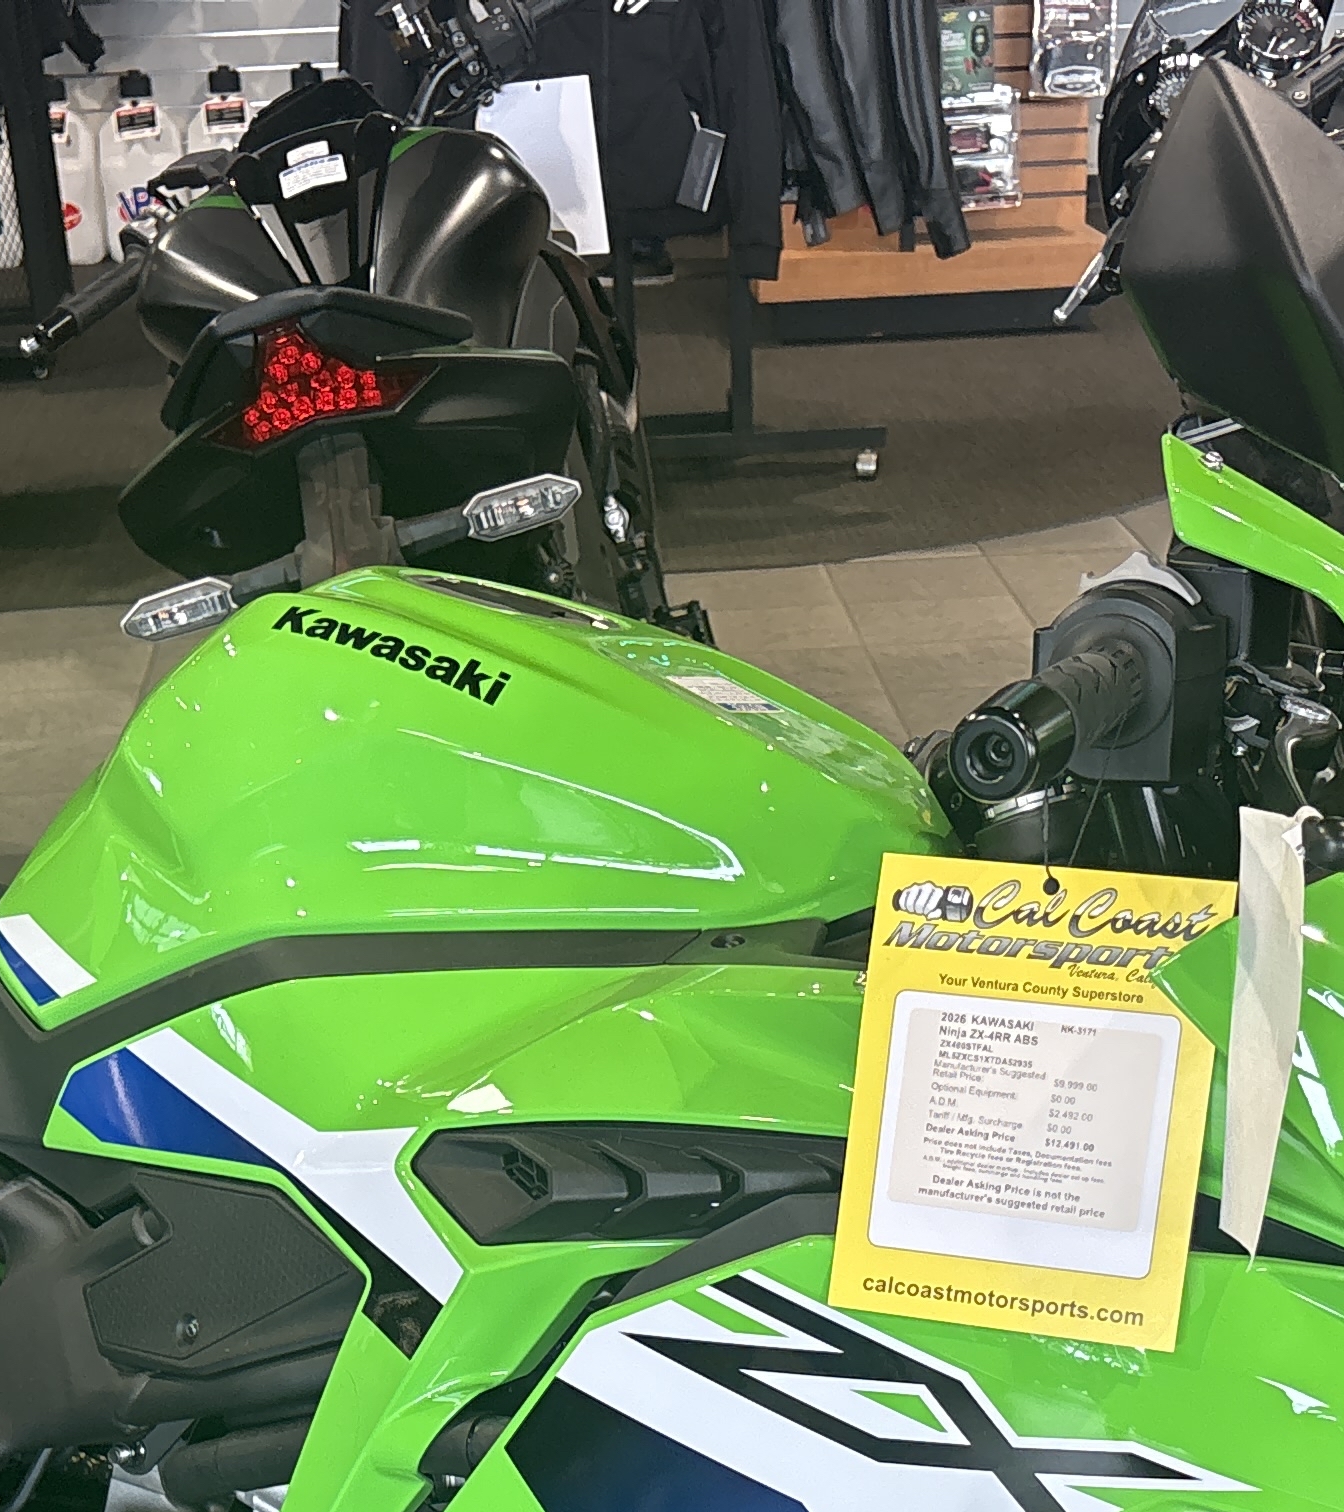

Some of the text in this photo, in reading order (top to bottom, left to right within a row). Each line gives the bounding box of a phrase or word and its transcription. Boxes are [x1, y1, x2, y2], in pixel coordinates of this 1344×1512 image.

[273, 606, 511, 707] Kawasaki
[973, 879, 1218, 942] Cal Coast
[882, 920, 1174, 969] Motorsport
[938, 973, 1144, 1004] Your Ventura County Superstore
[941, 1012, 967, 1024] 2026
[971, 1014, 1035, 1031] KAWASAKI
[939, 1026, 1039, 1046] Ninja ZX-4RR ABS
[932, 1068, 957, 1078] Retail
[999, 1067, 1046, 1081] Suggested
[931, 1081, 967, 1094] Optional
[925, 1122, 1016, 1143] Dealer Asking Price
[977, 1115, 1023, 1131] Surcharge
[932, 1174, 1081, 1203] Dealer Asking Price is not the
[918, 1186, 1106, 1219] manufacturer's suggested retail price
[862, 1274, 1145, 1328] calcoastmotorsports.com
